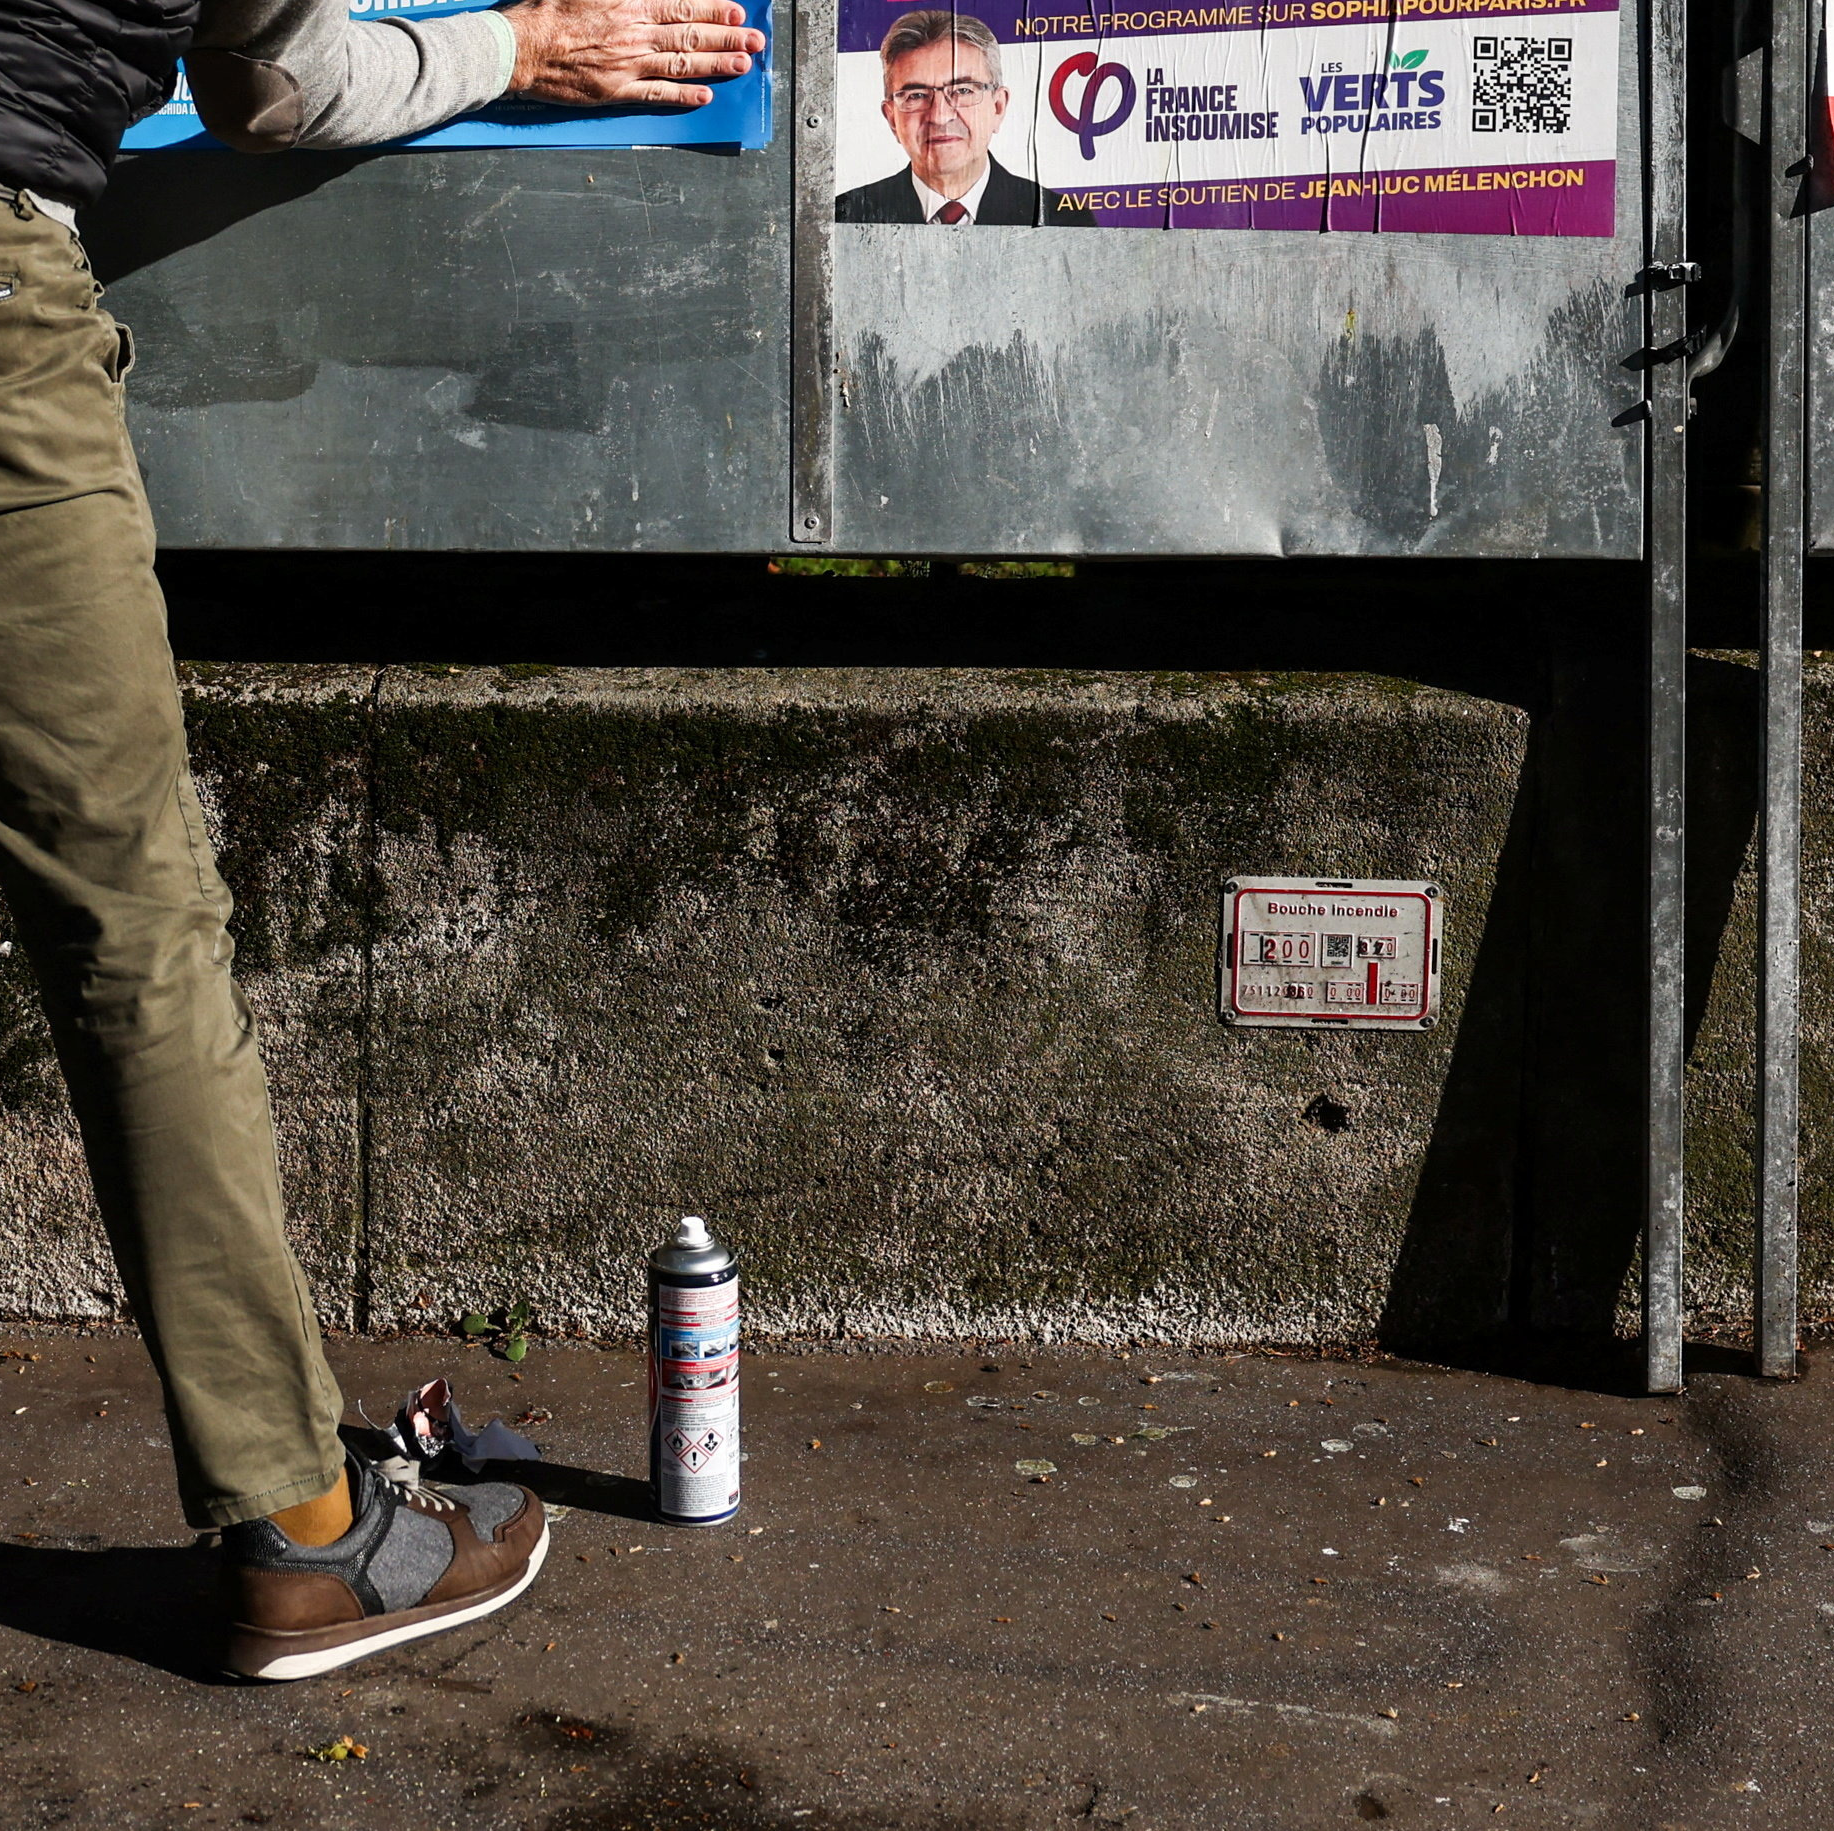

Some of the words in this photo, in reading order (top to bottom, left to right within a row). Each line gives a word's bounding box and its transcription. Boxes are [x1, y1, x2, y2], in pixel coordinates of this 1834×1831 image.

[1015, 15, 1094, 37] NOTRE
[1100, 5, 1254, 34] PROGRAMME
[1257, 3, 1308, 24] SUR
[1146, 68, 1164, 86] LA
[1320, 62, 1343, 74] LES
[1146, 85, 1238, 117] FRANCE
[1299, 69, 1446, 111] VERTS
[1300, 111, 1442, 135] POPULAIRES
[1057, 191, 1121, 212] AVEC
[1125, 190, 1153, 209] LE
[1158, 185, 1258, 207] SOUTIEN
[1264, 182, 1297, 201] DE
[1299, 176, 1421, 200] JEAN-LUC
[1424, 168, 1586, 193] MÉLENCHON
[1268, 902, 1326, 916] Bouche
[1264, 938, 1309, 960] 200
